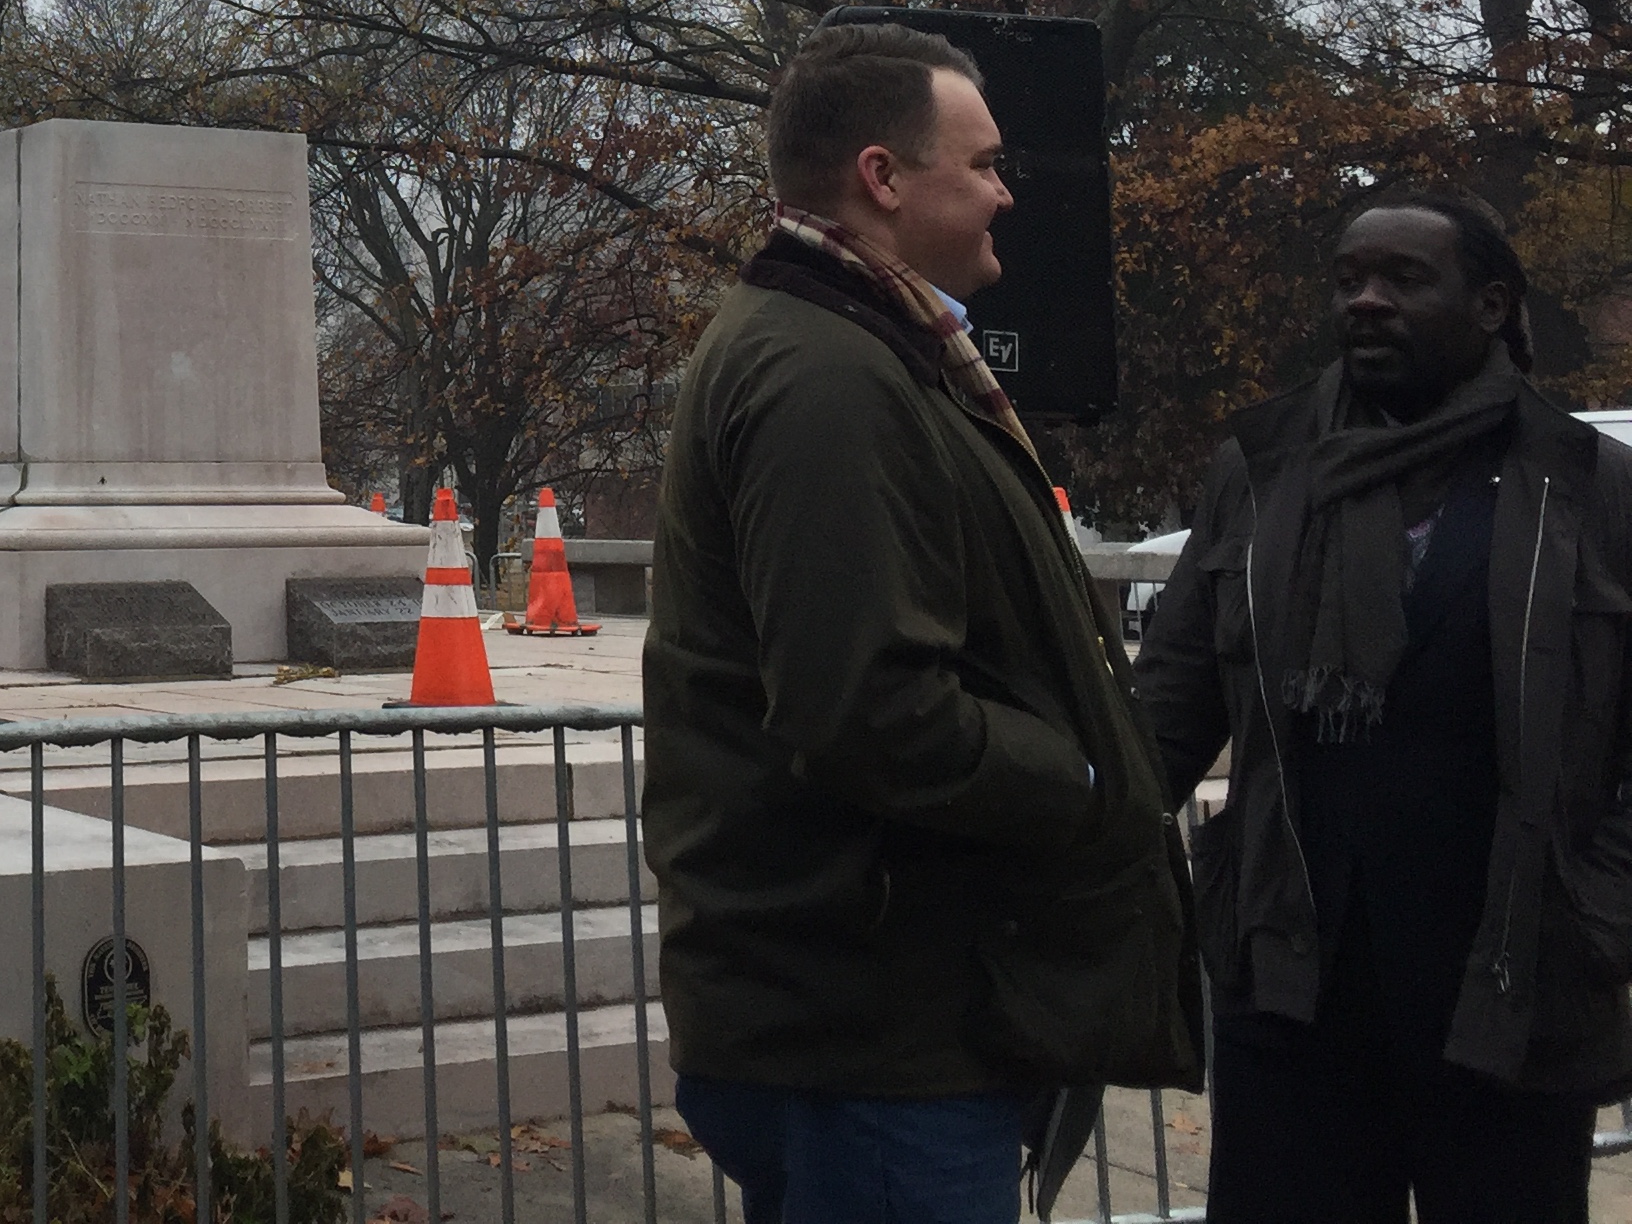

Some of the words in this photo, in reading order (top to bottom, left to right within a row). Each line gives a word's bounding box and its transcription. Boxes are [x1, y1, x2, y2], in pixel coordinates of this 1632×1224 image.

[73, 191, 140, 210] NATHAN
[146, 194, 218, 212] BEDFORD
[228, 198, 293, 215] FORREST
